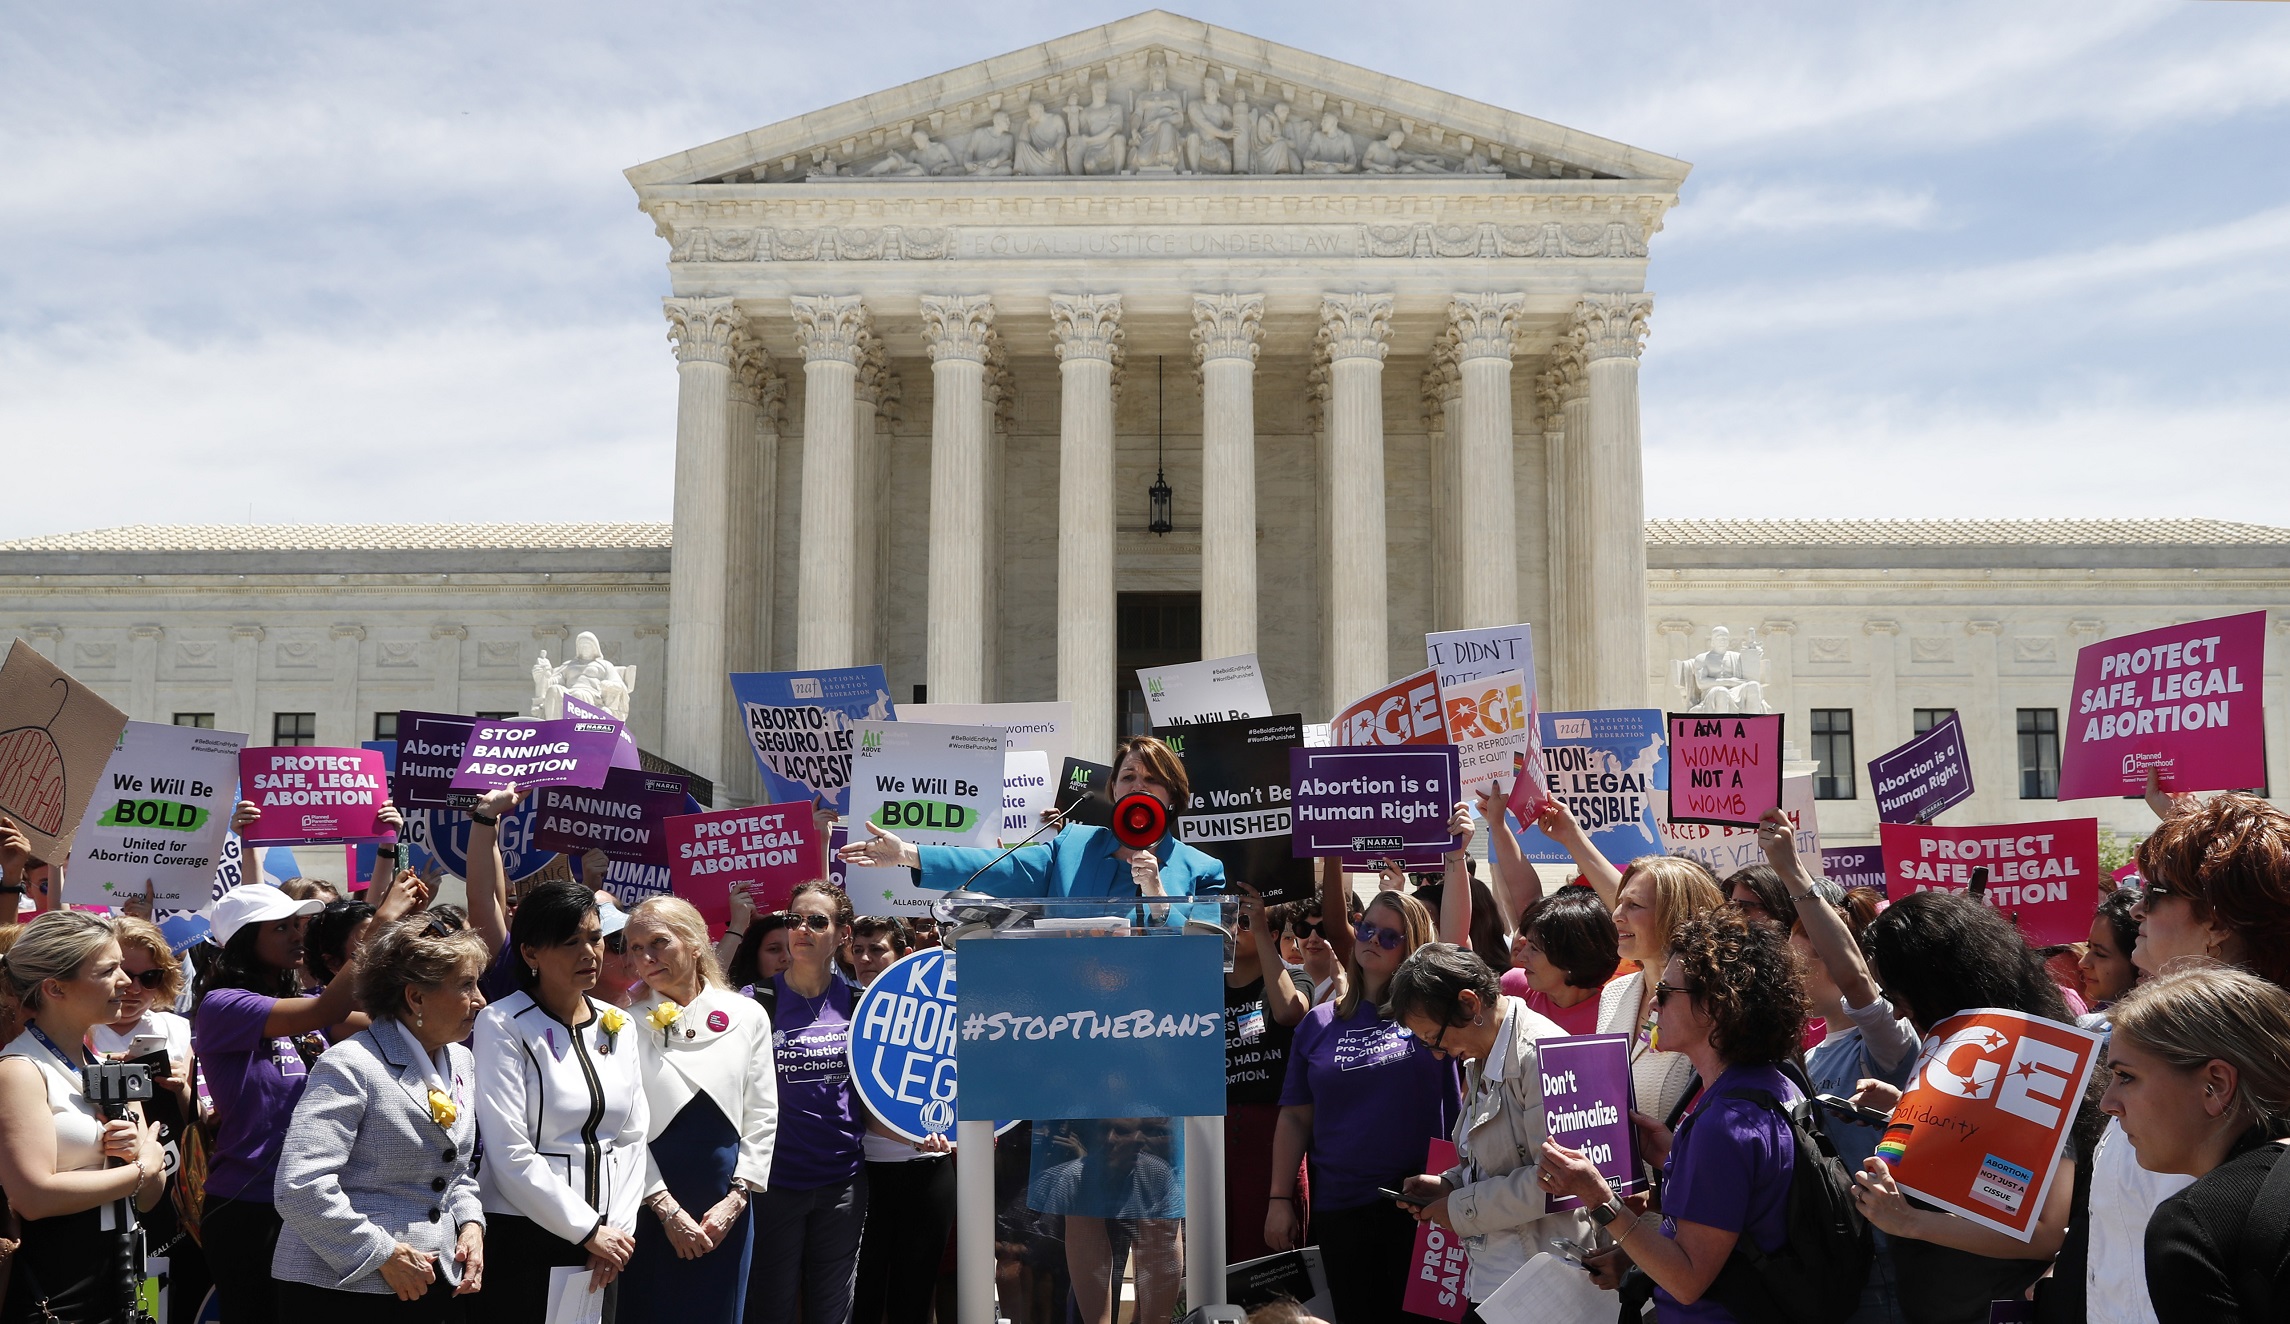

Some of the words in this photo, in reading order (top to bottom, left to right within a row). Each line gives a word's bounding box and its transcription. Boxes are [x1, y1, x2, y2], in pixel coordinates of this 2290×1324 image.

[974, 235, 1059, 256] EQUAL
[1073, 234, 1176, 256] JUSTICE
[1189, 233, 1278, 253] UNDER
[1288, 233, 1341, 253] LAW
[1428, 642, 1444, 667] I
[1454, 638, 1522, 664] DIDN'T
[2100, 636, 2221, 681] PROTECT
[822, 675, 866, 683] NATIONAL
[824, 682, 868, 690] ABORTION
[826, 689, 870, 698] FEDERATION
[2079, 680, 2144, 715] SAFE,
[2151, 666, 2244, 702] LEGAL
[750, 707, 829, 730] ABORTO:
[1444, 683, 1525, 742] RGE
[2082, 700, 2229, 743] ABORTION
[480, 728, 537, 741] STOP
[586, 724, 614, 732] NARAL
[1006, 722, 1055, 734] women's
[1248, 733, 1296, 743] #WontBePunished
[1249, 725, 1295, 735] #BeBoldEndHyde
[1679, 721, 1684, 738] I
[1734, 721, 1746, 738] A
[403, 740, 466, 758] Aborti
[755, 730, 825, 754] SEGURO,
[951, 735, 998, 744] #BeBoldEndHyde
[1458, 745, 1474, 756] OR
[1476, 732, 1525, 752] REPRODUCTIVE
[472, 742, 570, 759] BANNING
[1480, 750, 1508, 766] EQUITY
[1543, 748, 1594, 772] TION:
[1682, 743, 1759, 769] WOMAN
[2136, 752, 2162, 760] Planned
[271, 756, 362, 771] PROTECT
[465, 759, 578, 778] ABORTION
[768, 754, 779, 773] Y
[1878, 758, 1934, 796] Abortion
[1934, 750, 1945, 765] is
[1947, 744, 1954, 757] a
[2136, 759, 2174, 768] Parenthood
[114, 774, 142, 792] We
[150, 778, 184, 796] Will
[190, 781, 213, 798] Be
[254, 774, 312, 790] SAFE,
[318, 774, 379, 788] LEGAL
[656, 782, 680, 790] NARAL
[876, 776, 905, 792] We
[912, 778, 948, 796] Will
[954, 780, 979, 797] Be
[1298, 776, 1395, 796] Abortion
[1401, 775, 1418, 793] is
[1426, 779, 1439, 792] a
[1691, 768, 1723, 788] NOT
[1731, 770, 1744, 788] A
[1881, 784, 1928, 814] Human
[1928, 762, 1958, 790] Right
[262, 790, 372, 806] ABORTION
[460, 796, 478, 804] NAR
[1210, 786, 1262, 806] Won't
[1269, 785, 1292, 801] Be
[1688, 794, 1746, 816] WOMB
[115, 799, 197, 828] BOLD
[546, 792, 642, 820] BANNING
[882, 800, 965, 828] BOLD
[1299, 804, 1374, 821] Human
[1380, 800, 1439, 824] Right
[1926, 800, 1943, 814] NARAL
[544, 816, 650, 844] ABORTION
[694, 814, 784, 838] PROTECT
[1004, 814, 1027, 829] All!
[1182, 813, 1291, 838] PUNISHED
[123, 838, 166, 852] United
[170, 840, 187, 852] for
[680, 838, 736, 859] SAFE,
[742, 830, 804, 852] LEGAL
[1367, 838, 1400, 846] NARAL
[1920, 834, 2054, 860] PROTECT
[88, 849, 148, 865] Abortion
[154, 854, 208, 868] Coverage
[690, 848, 798, 876] ABORTION
[1822, 854, 1866, 868] STOP
[1987, 857, 2080, 884] LEGAL
[777, 1045, 848, 1060] Pro-Justice.
[1234, 1052, 1260, 1066] HAD
[1263, 1048, 1282, 1061] AN
[778, 1059, 846, 1073] Pro-Choice.
[871, 1044, 957, 1104] LEG
[1542, 1070, 1578, 1096] Don't
[1547, 1100, 1618, 1136] Criminalize
[1980, 1170, 1998, 1180] NOT
[1998, 1177, 2018, 1189] JUST
[1986, 1159, 2030, 1180] ABORTION:
[1984, 1186, 2012, 1202] CISSUE
